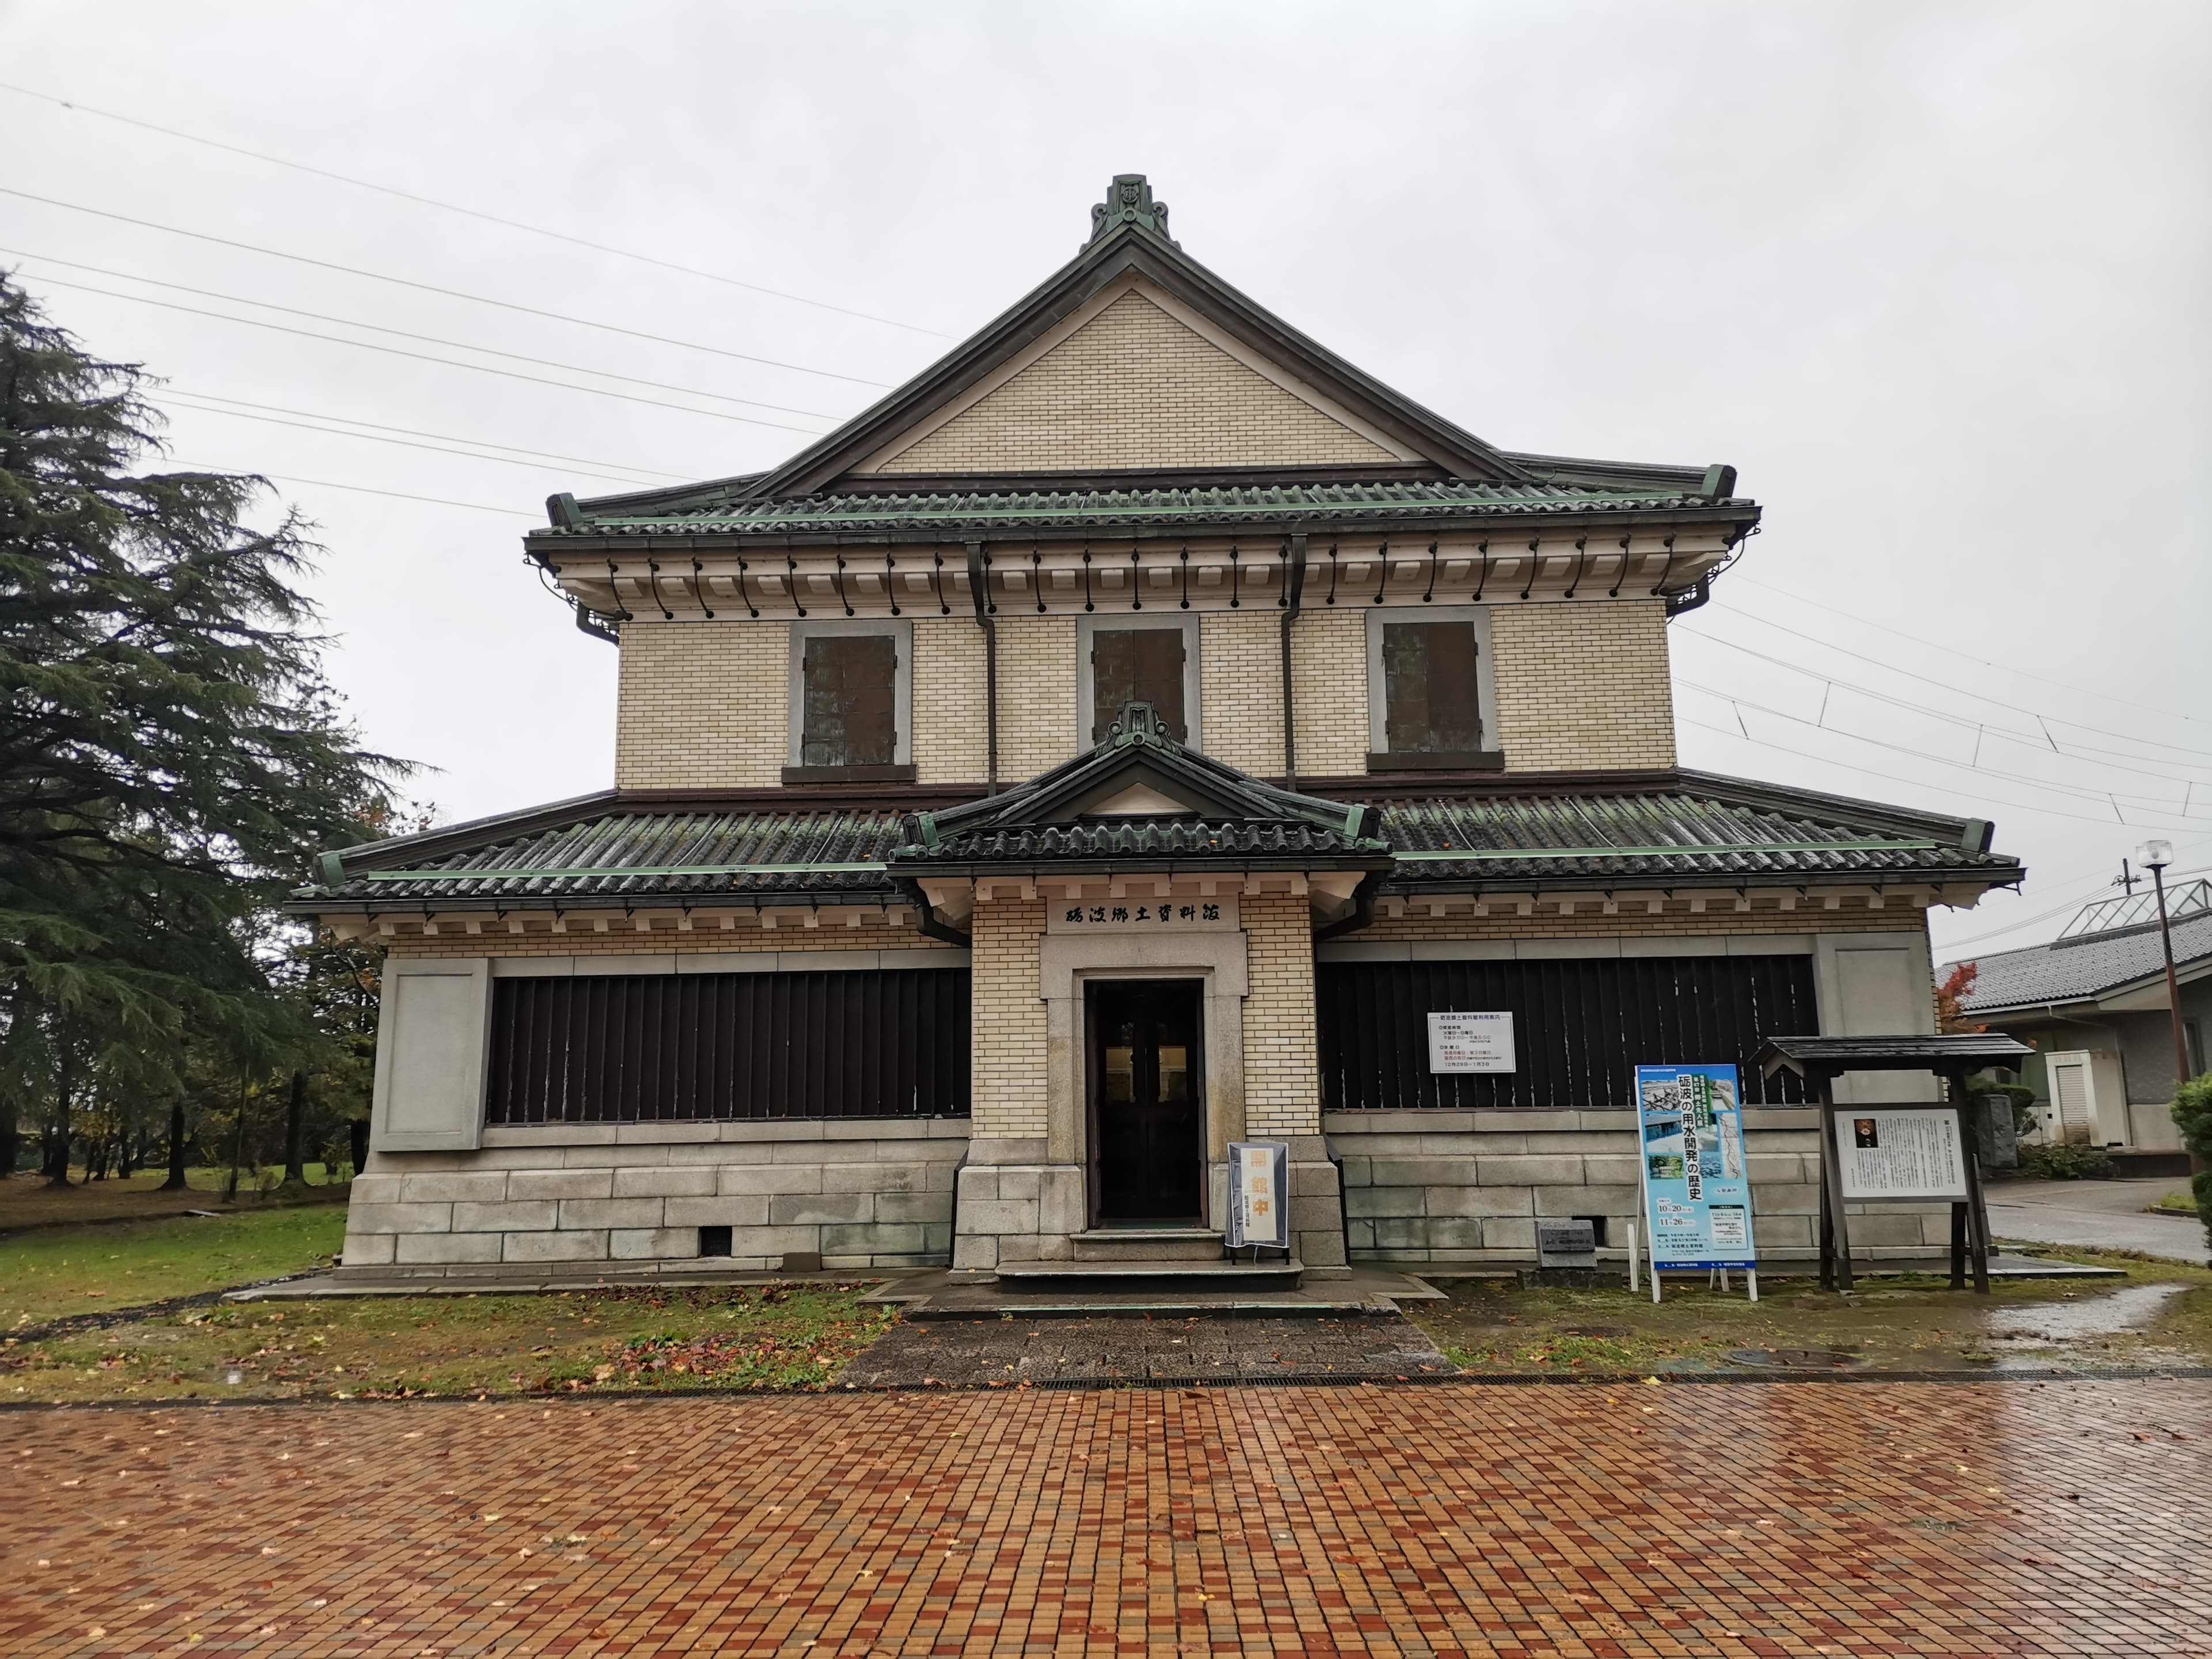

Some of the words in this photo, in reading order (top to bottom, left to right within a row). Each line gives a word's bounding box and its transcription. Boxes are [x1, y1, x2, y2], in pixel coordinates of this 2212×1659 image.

[1679, 1076, 1702, 1200] 砺波の用水開発の歴史
